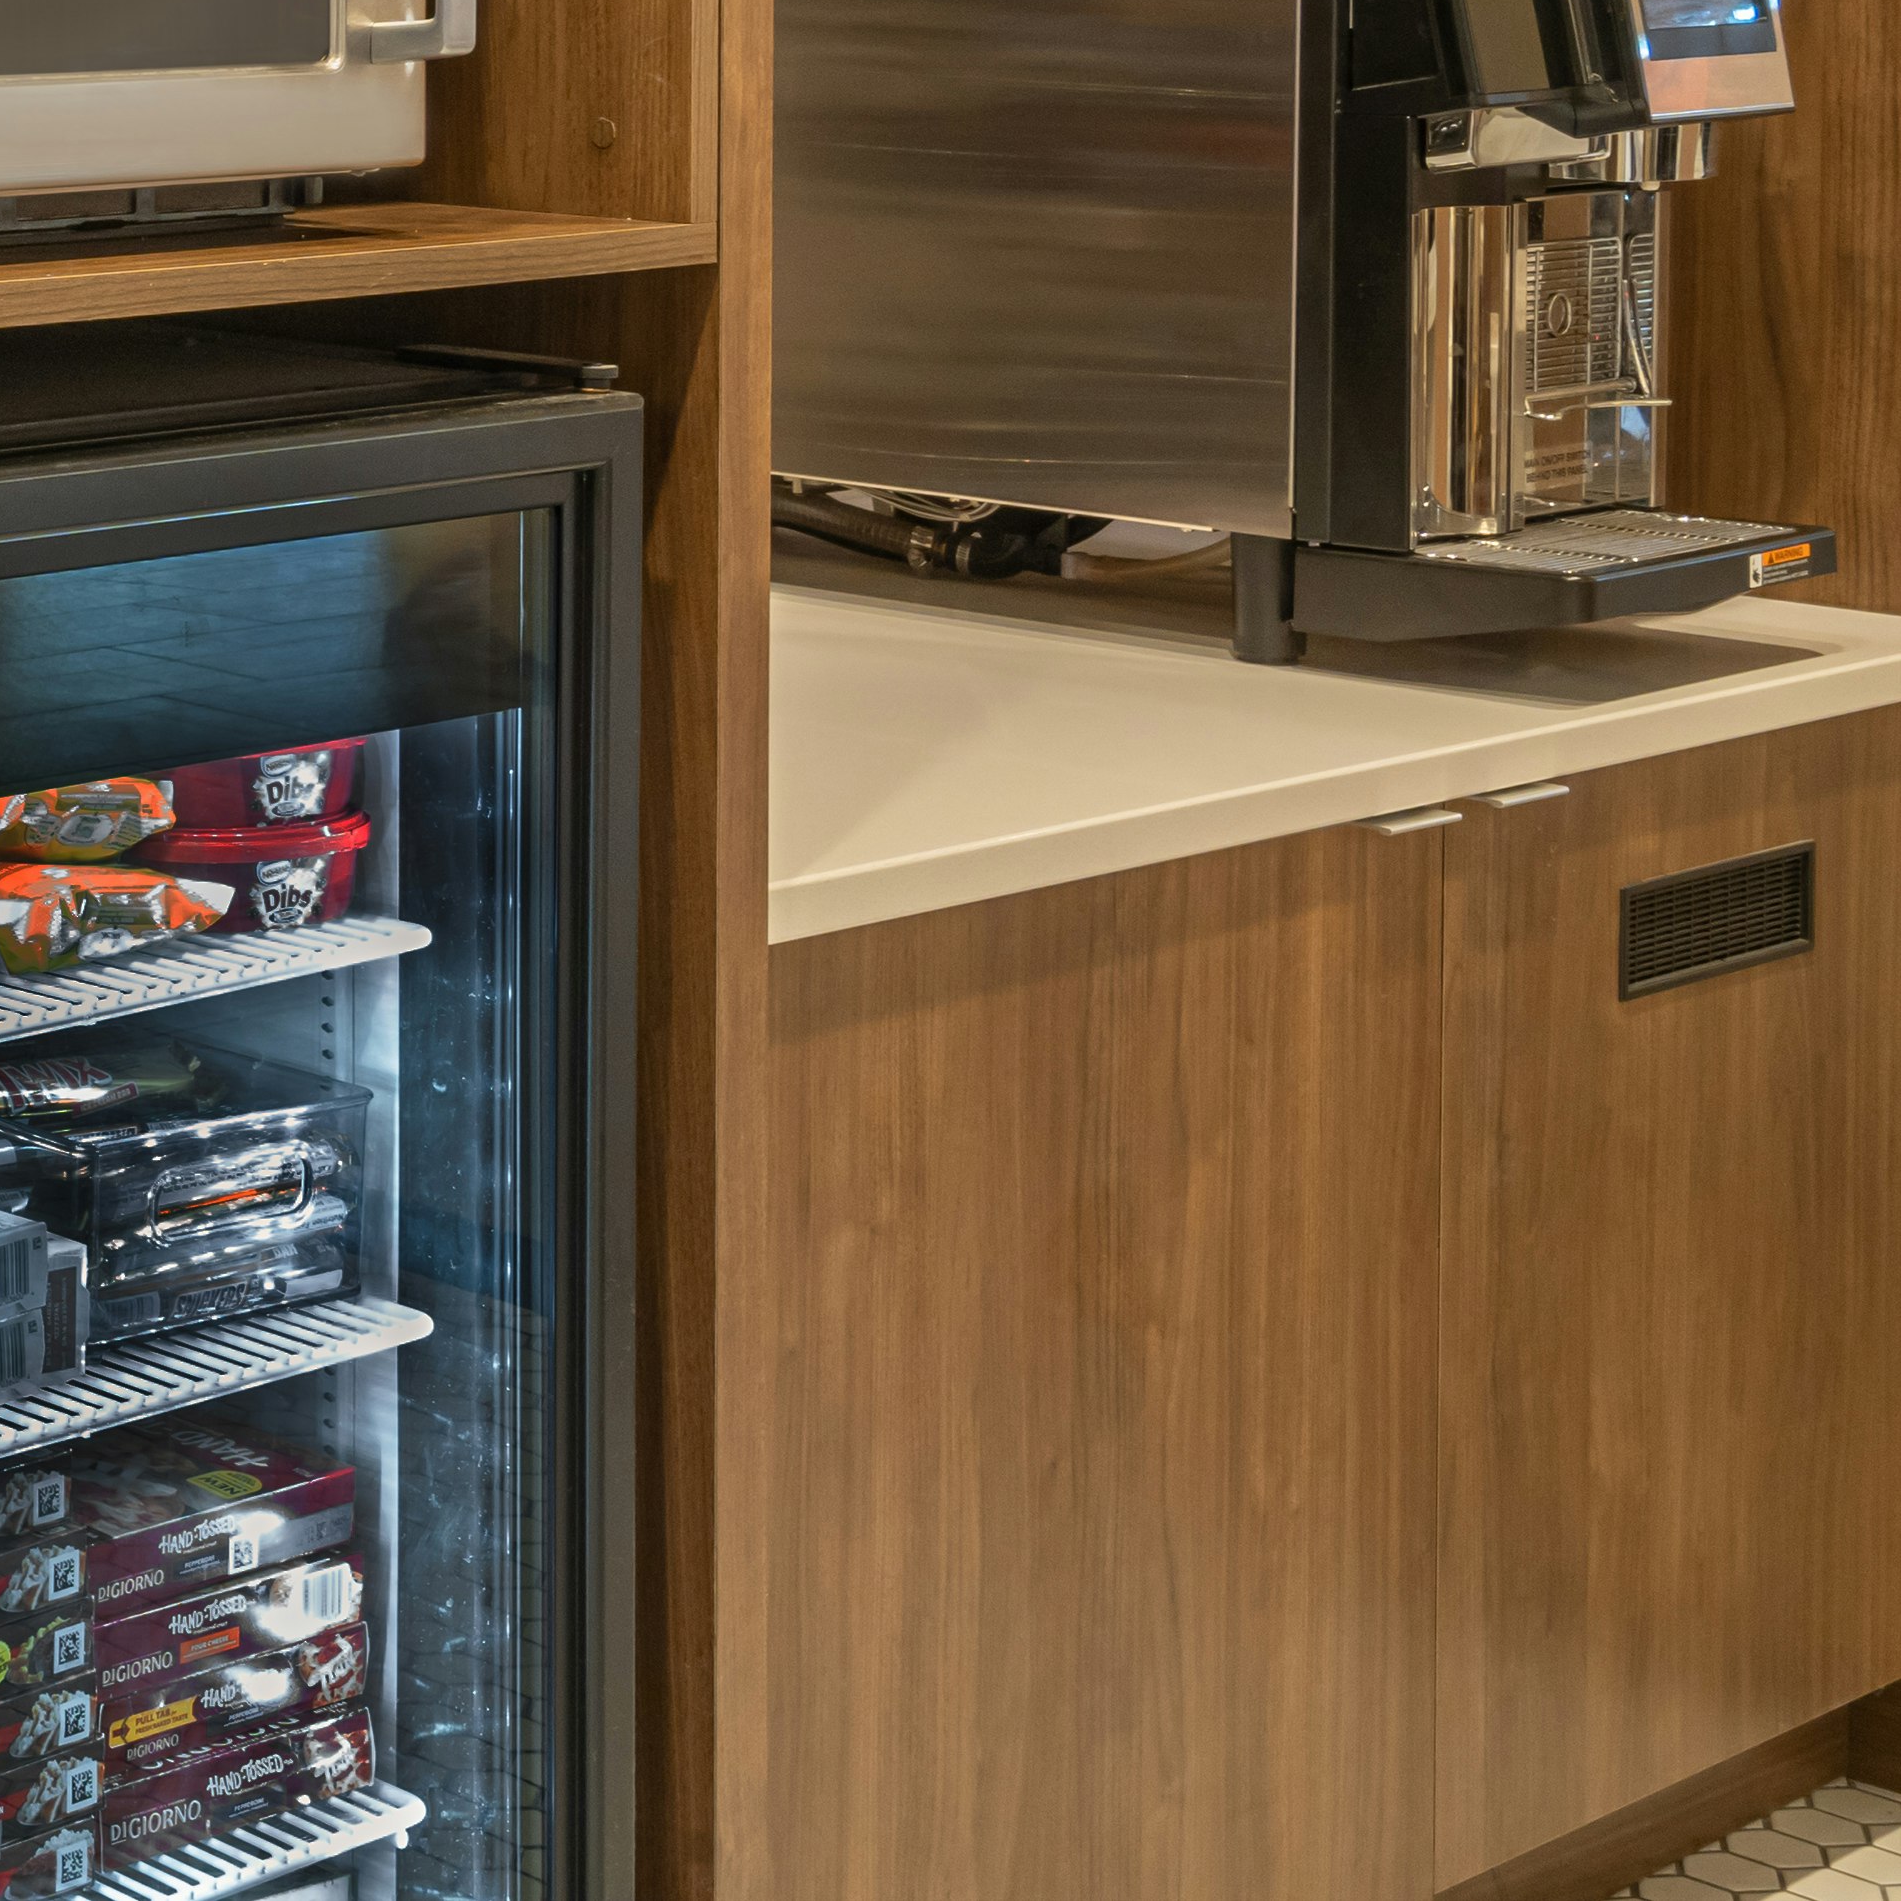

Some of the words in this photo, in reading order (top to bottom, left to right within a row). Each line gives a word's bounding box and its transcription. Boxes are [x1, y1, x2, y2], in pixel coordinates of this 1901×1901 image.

[1773, 548, 1805, 562] WARNING
[264, 884, 311, 912] Dibs
[98, 1569, 165, 1601] DIGIORNO
[102, 1652, 173, 1687] DIGIORNO
[136, 1714, 155, 1726] PULL
[156, 1710, 170, 1722] TAB
[111, 1800, 202, 1844] DIGIORNO
